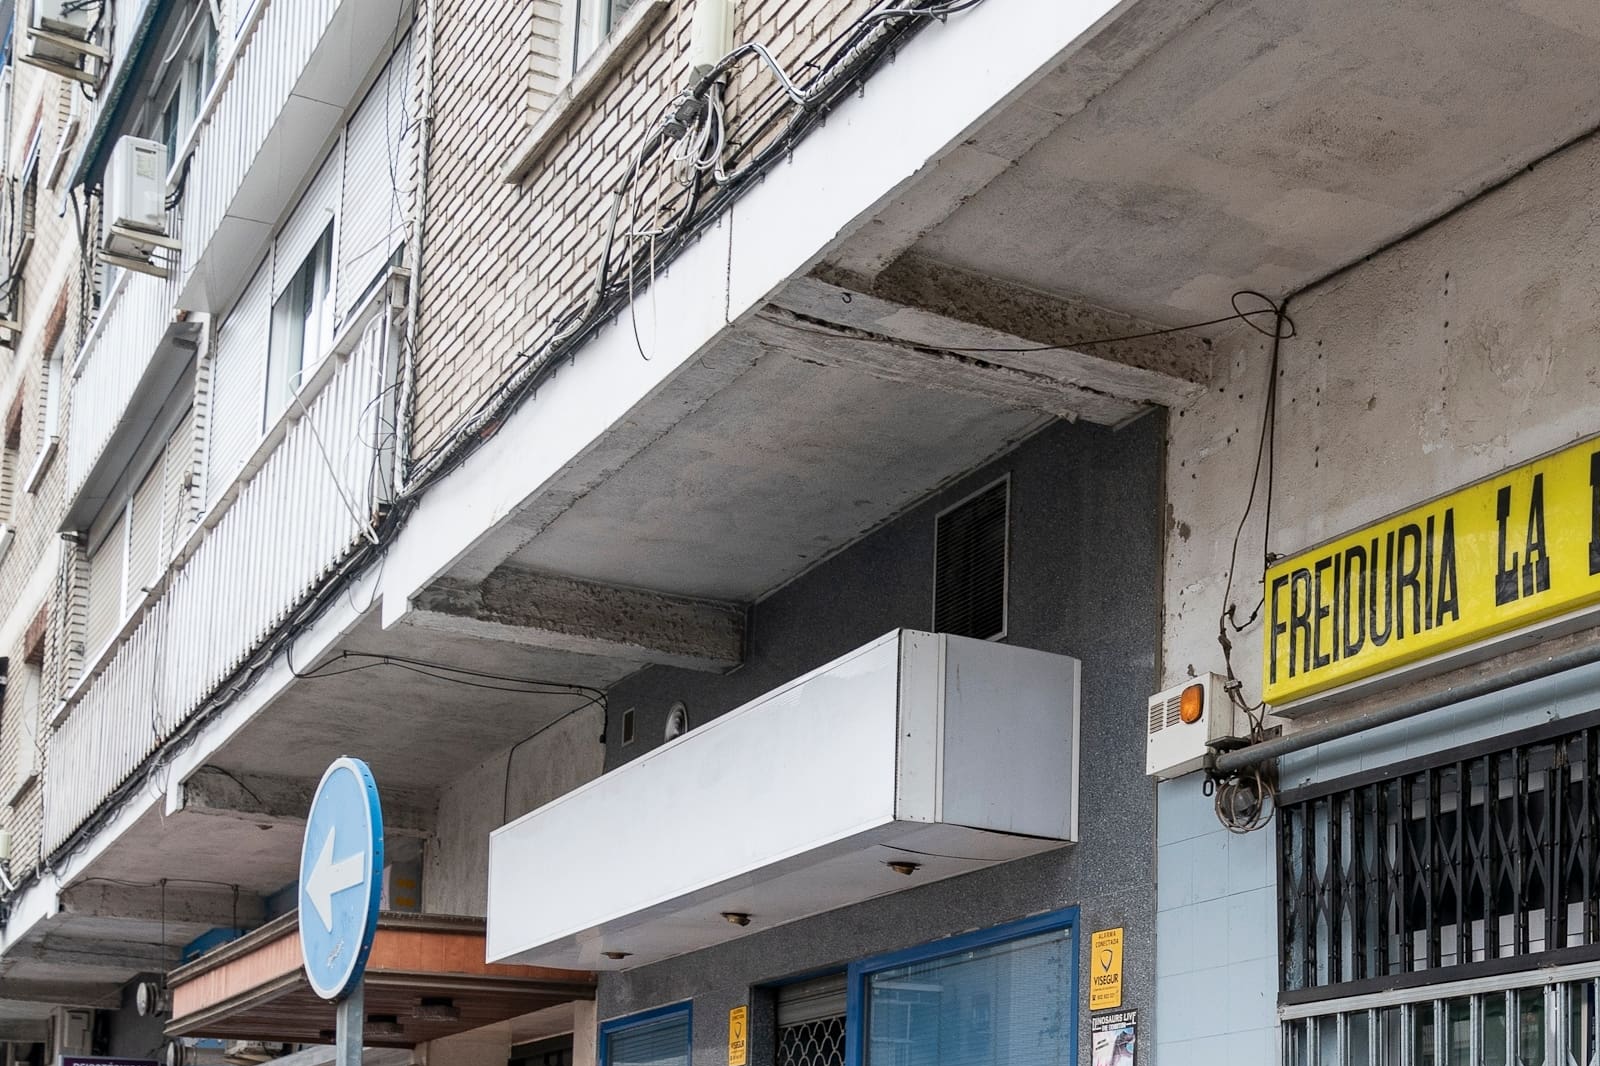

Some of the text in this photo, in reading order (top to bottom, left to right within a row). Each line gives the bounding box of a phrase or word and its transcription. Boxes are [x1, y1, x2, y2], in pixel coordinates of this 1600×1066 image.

[1269, 507, 1460, 685] FREIDURIA
[1495, 472, 1552, 607] LA
[1093, 973, 1119, 986] VISEGUR
[1092, 1013, 1123, 1030] DINOSAURS
[1123, 1011, 1137, 1025] LIVE
